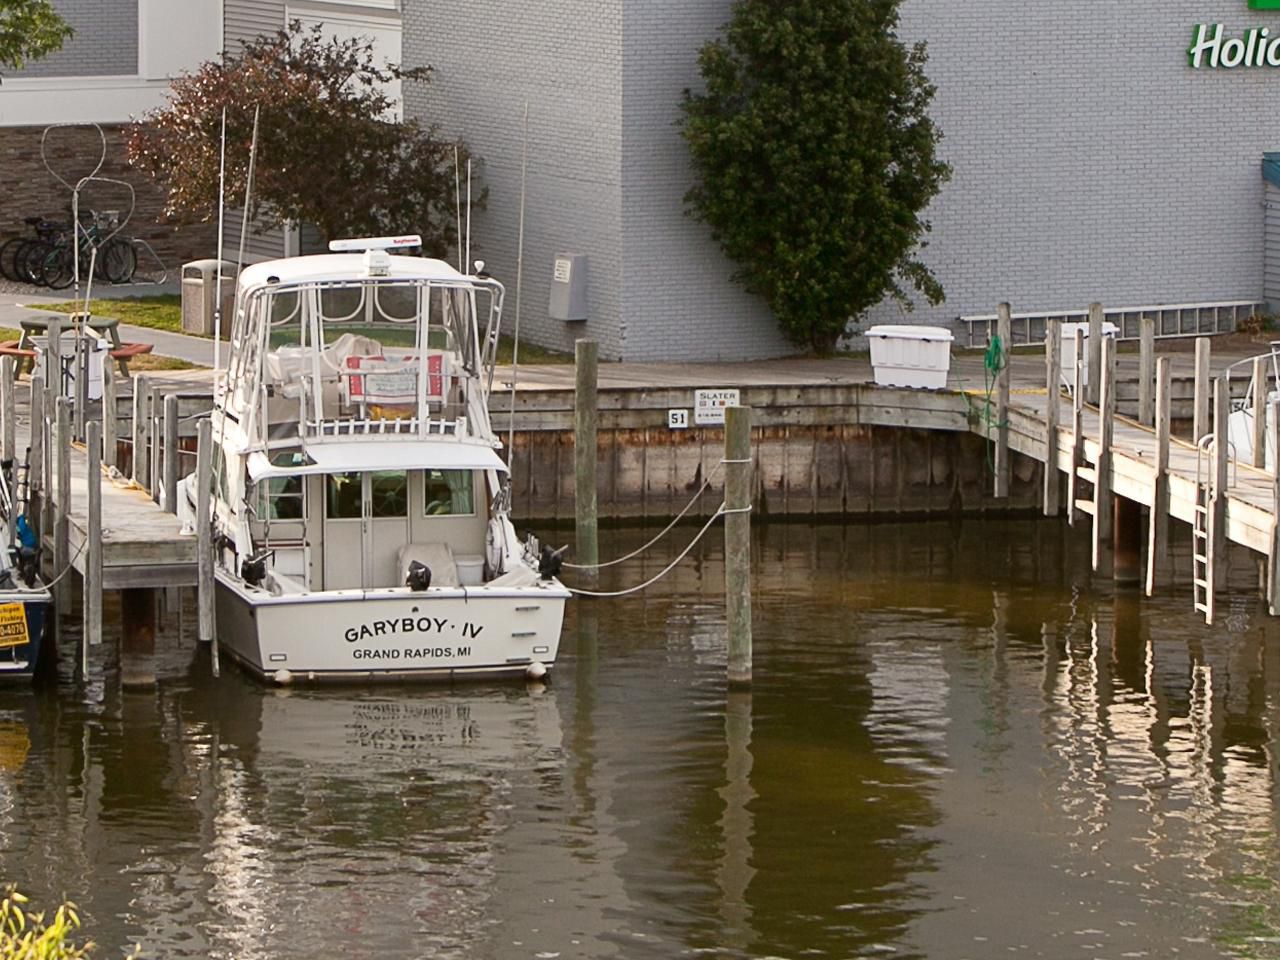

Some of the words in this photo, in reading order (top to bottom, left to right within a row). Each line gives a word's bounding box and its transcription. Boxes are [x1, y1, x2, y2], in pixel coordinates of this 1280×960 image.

[671, 413, 684, 424] 51
[344, 617, 448, 643] GARYBOY
[462, 622, 484, 639] IV
[353, 649, 400, 659] GRAND
[404, 647, 455, 658] RAPIDS,
[457, 646, 471, 656] MI
